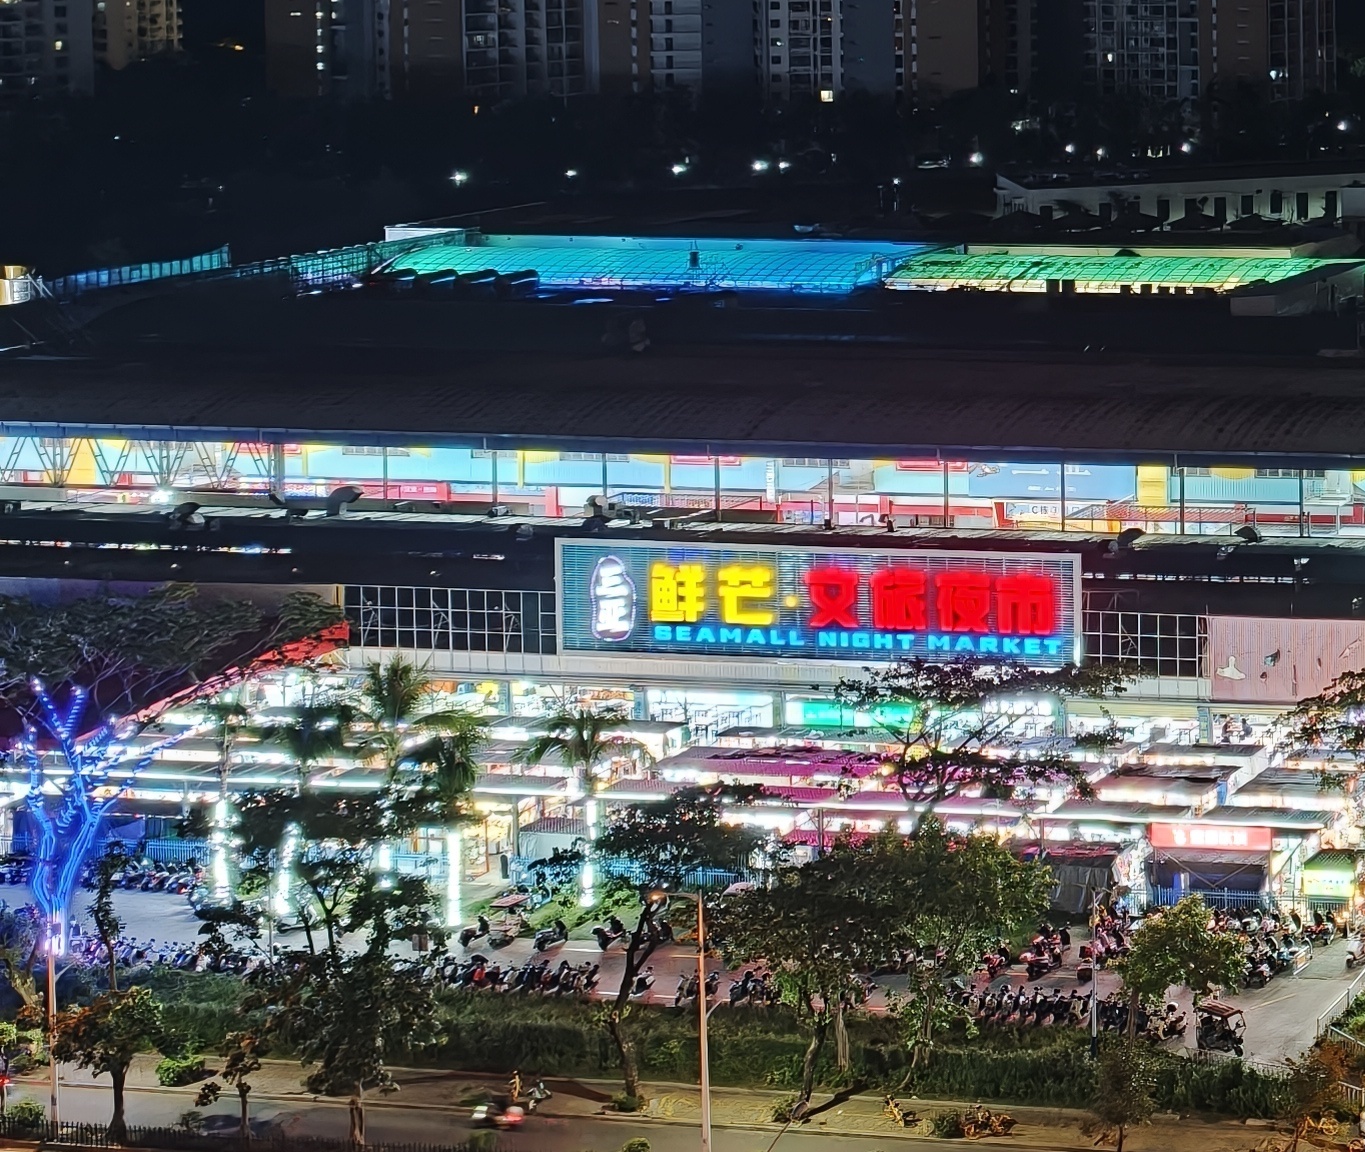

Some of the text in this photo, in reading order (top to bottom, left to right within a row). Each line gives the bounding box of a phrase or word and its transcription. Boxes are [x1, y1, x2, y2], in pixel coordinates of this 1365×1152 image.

[595, 565, 630, 633] 三亚
[650, 561, 1056, 634] 鲜芒·文旅夜市
[652, 625, 1062, 655] SEAMALL NIGHT MARKET
